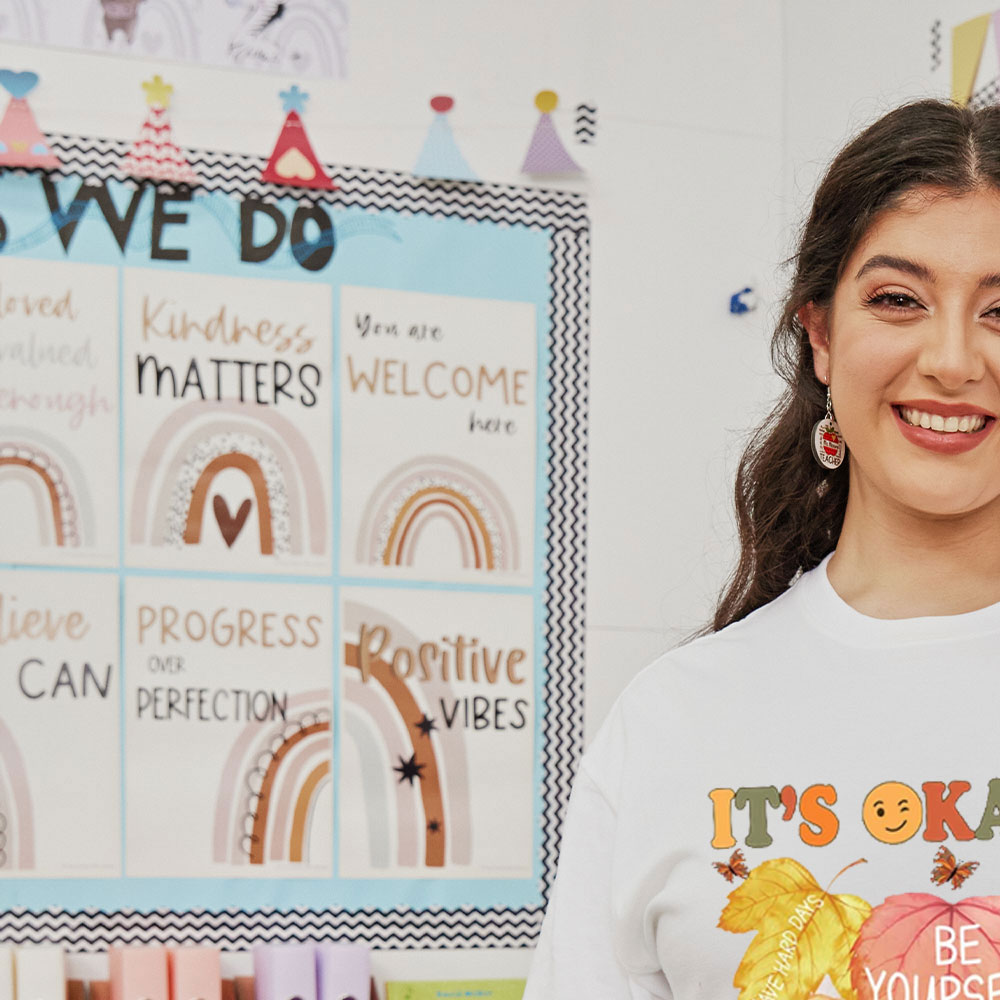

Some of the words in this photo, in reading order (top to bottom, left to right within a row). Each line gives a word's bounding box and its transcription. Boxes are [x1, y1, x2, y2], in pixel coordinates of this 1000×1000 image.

[42, 174, 193, 262] WE
[240, 196, 335, 271] DO
[141, 295, 316, 355] Kindness
[355, 313, 400, 339] You
[408, 321, 445, 343] are
[136, 354, 322, 408] MATTERS
[347, 354, 529, 406] WELCOME
[468, 410, 517, 437] here
[137, 605, 322, 649] PROGRESS
[148, 655, 187, 675] OVER
[357, 622, 528, 684] Positive
[18, 658, 112, 699] CAN
[137, 687, 289, 723] PERFECTION
[438, 696, 529, 731] VIBES
[708, 783, 840, 849] IT'S
[773, 929, 799, 977] HARD
[788, 894, 825, 931] DAYS
[934, 924, 983, 966] BE
